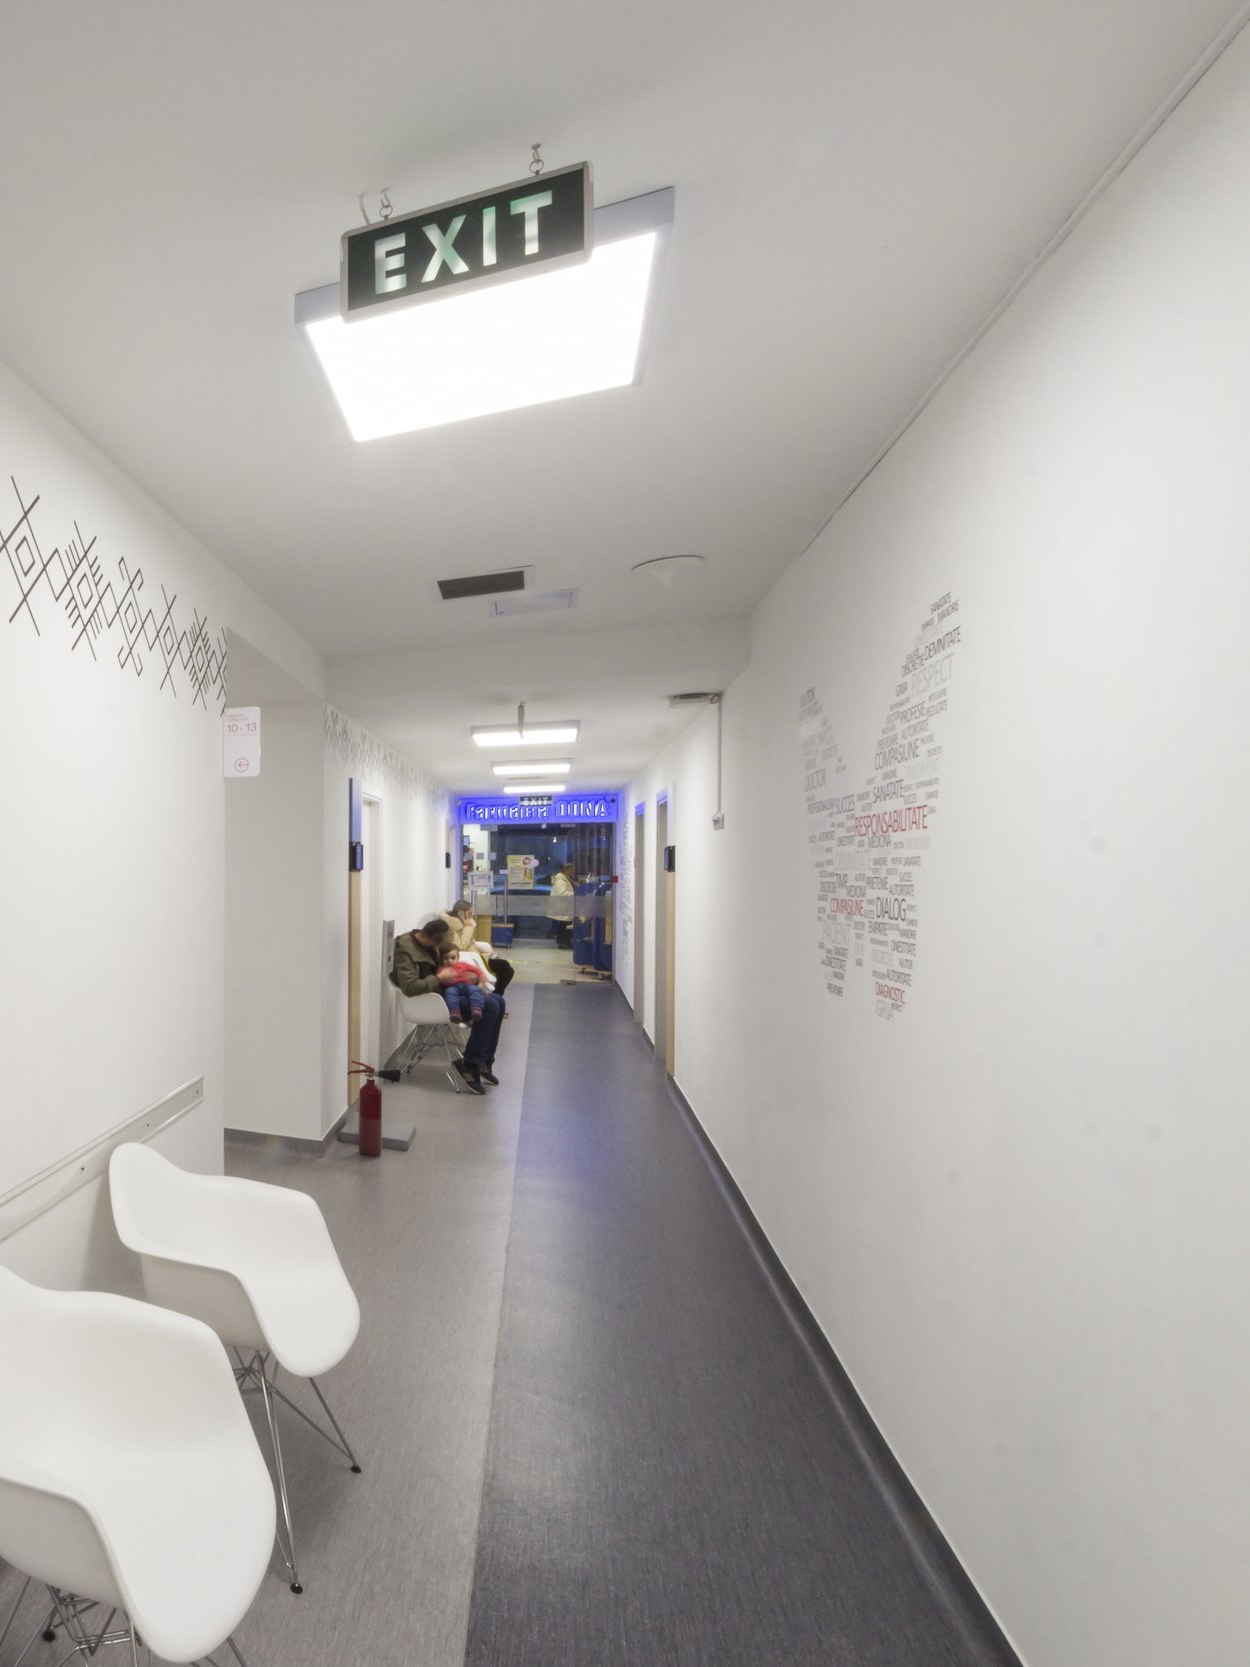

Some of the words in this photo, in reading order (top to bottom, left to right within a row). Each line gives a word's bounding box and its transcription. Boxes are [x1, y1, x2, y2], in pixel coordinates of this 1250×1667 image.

[374, 190, 553, 295] EXIT
[924, 626, 962, 661] DEMNITATE
[911, 653, 955, 697] RESPECT
[227, 723, 238, 734] 10
[246, 722, 257, 733] 13
[875, 738, 920, 770] COMPASIUNE
[523, 797, 548, 806] EXIT
[835, 793, 855, 815] SUCCES
[872, 779, 904, 804] SANATATE
[556, 799, 610, 819] DONA
[854, 804, 928, 837] RESPONSABILITATE
[830, 898, 864, 917] COMPASIUNE
[876, 896, 907, 922] DIALOG
[875, 981, 906, 1005] DIAGNOSTIC
